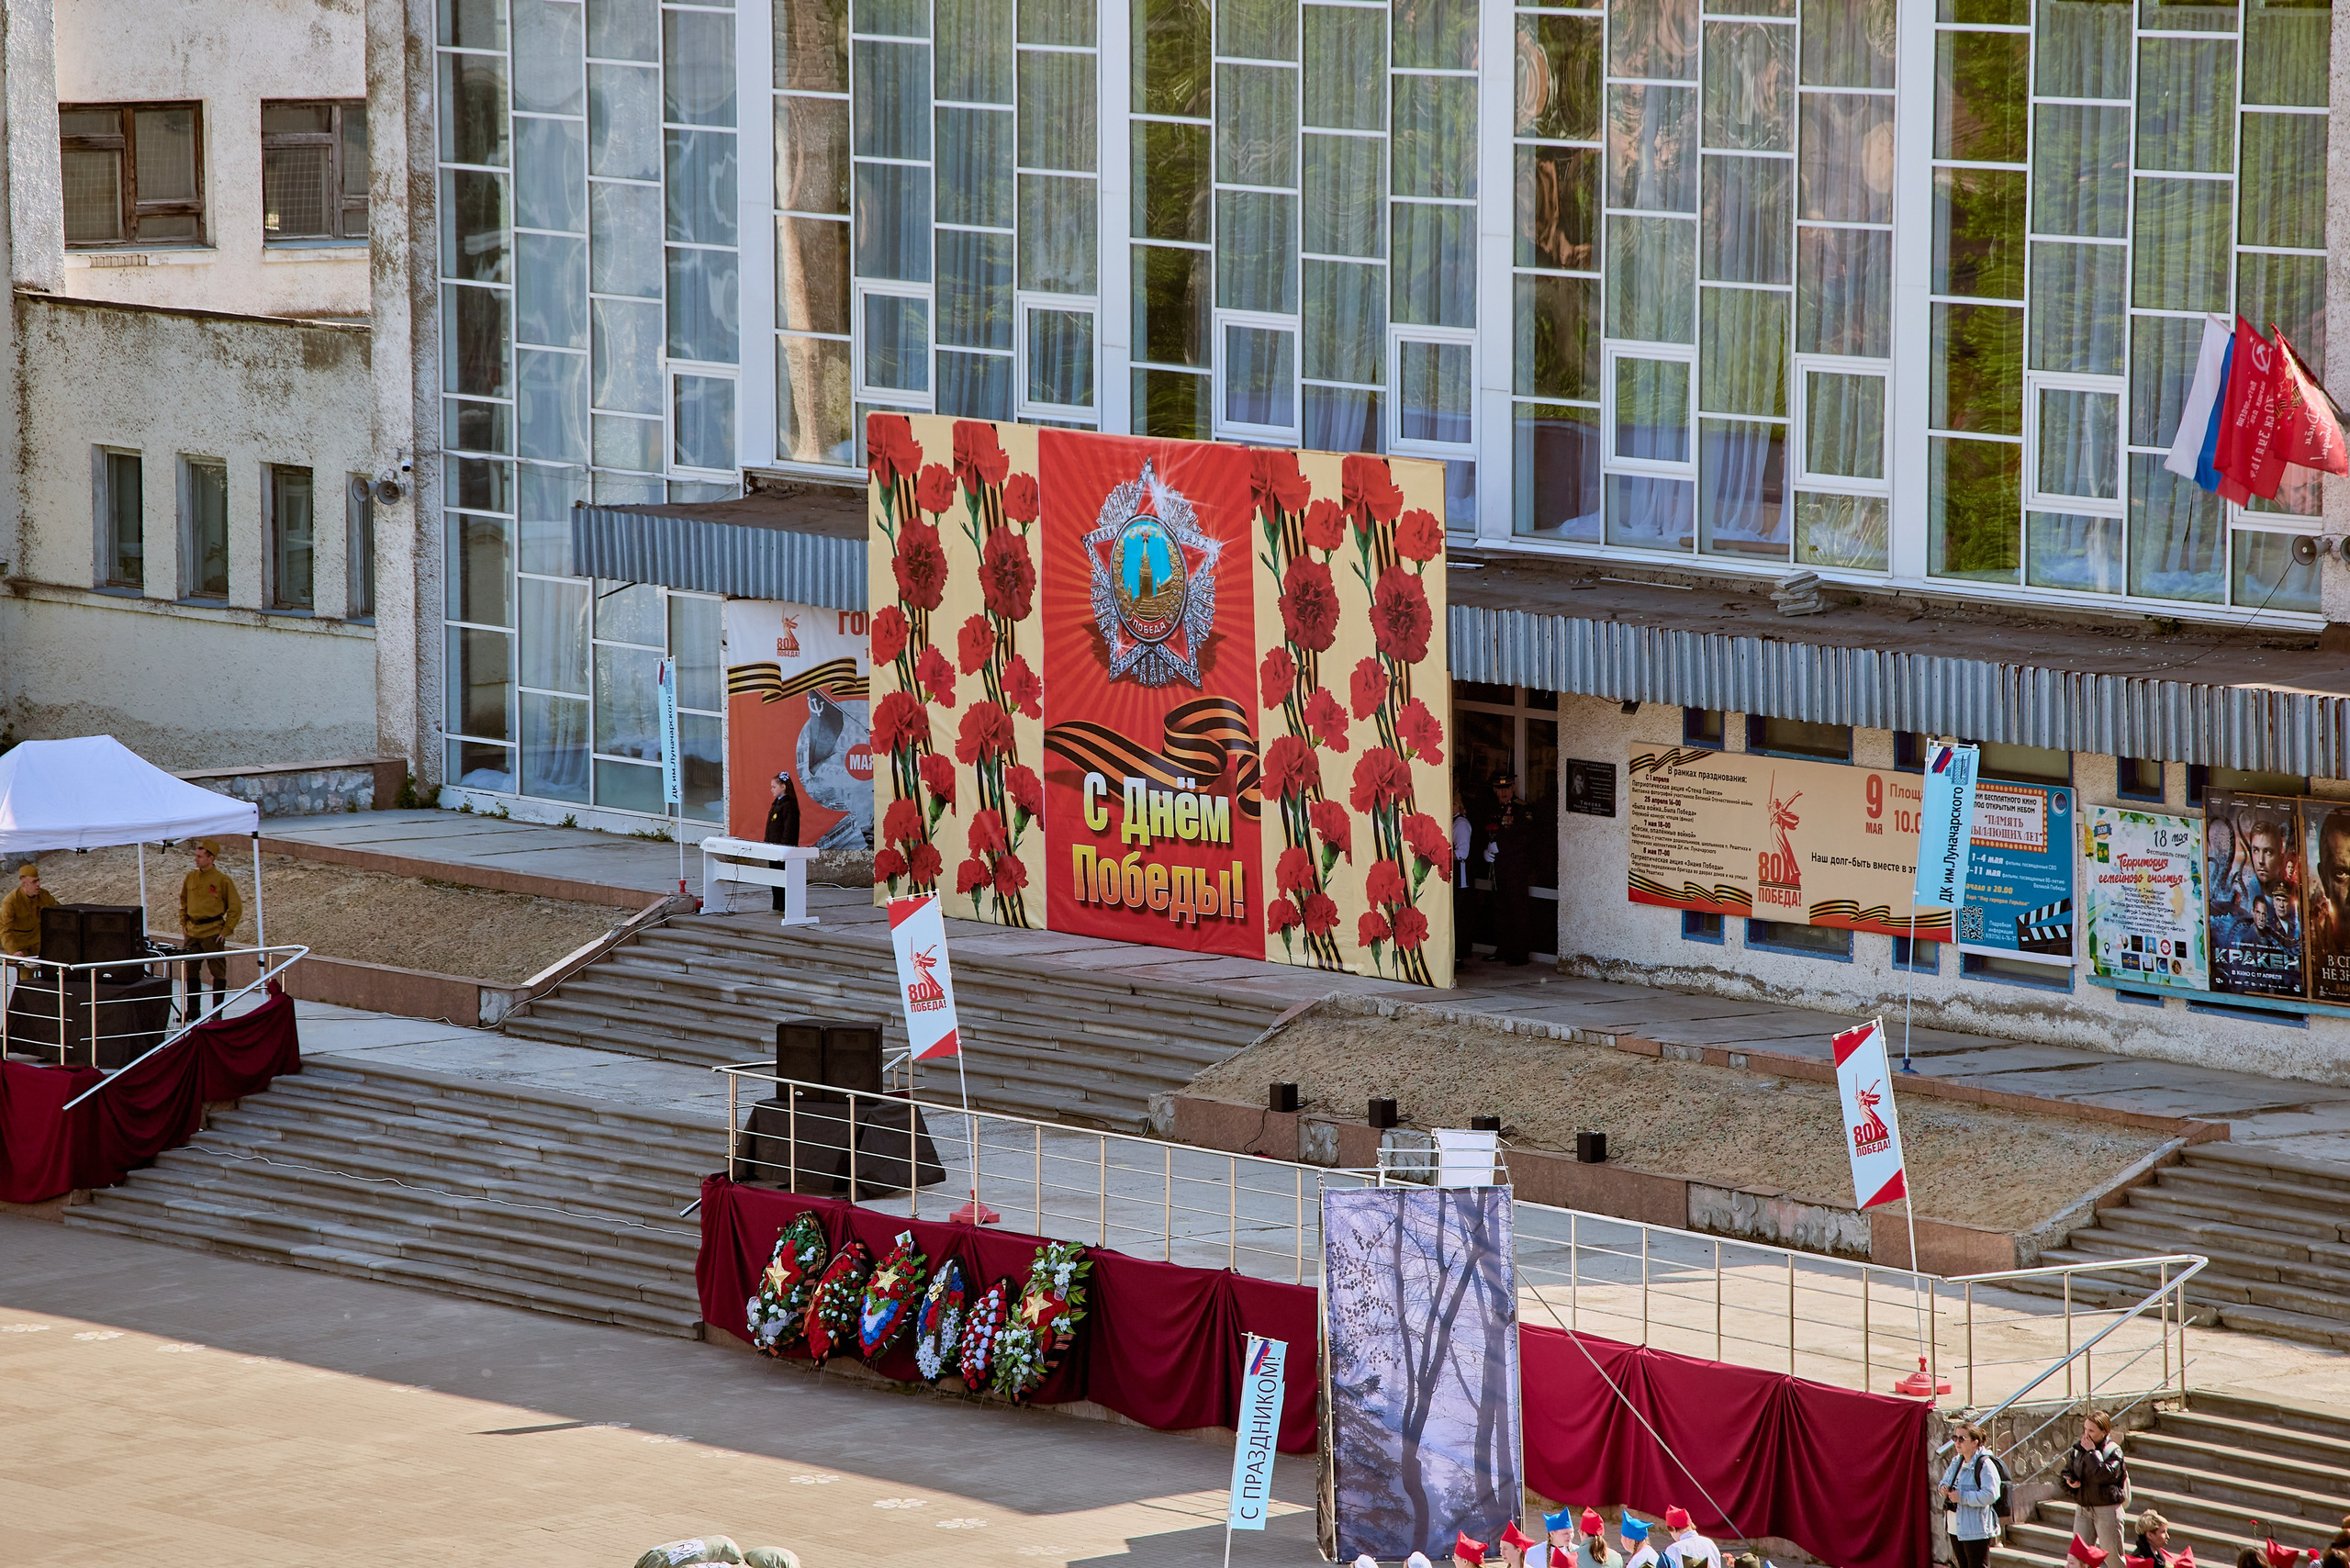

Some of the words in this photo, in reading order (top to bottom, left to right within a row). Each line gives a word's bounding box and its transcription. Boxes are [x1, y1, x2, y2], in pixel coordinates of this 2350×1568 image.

[1133, 619, 1166, 635] ПОБЕДА
[777, 637, 789, 649] 80
[1668, 766, 1673, 775] В
[1674, 769, 1696, 778] рамках
[1699, 772, 1747, 783] празднования:
[673, 784, 678, 799] ДК
[1632, 779, 1669, 790] Патриотическая
[1866, 774, 1883, 819] 9
[1985, 794, 2021, 804] БЕСПЛАТНОГО
[1083, 771, 1108, 831] С
[1121, 777, 1230, 846] Днём
[1986, 802, 2016, 812] ОТКРЫТЫМ
[1865, 822, 1883, 835] МАЯ
[1895, 810, 1922, 834] 10.0
[2154, 830, 2167, 847] 18
[2172, 833, 2188, 846] мая
[1631, 853, 1668, 863] Патриотическая
[1972, 853, 1986, 862] 1-4
[1987, 856, 2004, 865] мая
[2146, 848, 2174, 857] Фестиваль
[1759, 852, 1781, 882] 80
[1812, 852, 1829, 863] Наш
[1830, 856, 1871, 868] долг-быть
[1874, 862, 1899, 872] вместе
[1908, 866, 1917, 874] эт
[1986, 868, 2001, 878] мая
[2098, 872, 2143, 883] семейного
[1072, 843, 1244, 924] Победы!
[1965, 883, 1986, 891] ачало
[1993, 885, 2013, 894] 20.00
[1758, 887, 1801, 909] ПОБЕДА!
[1939, 886, 1953, 903] ДК
[2215, 947, 2300, 971] КРАКЕН
[2327, 955, 2334, 967] В
[2322, 968, 2337, 980] НЕ
[908, 982, 927, 1001] 80
[911, 1000, 947, 1013] ПОБЕДА!
[1853, 1123, 1874, 1144] 80
[1856, 1140, 1891, 1157] ПОБЕДА!
[1243, 1356, 1282, 1499] ПРАЗДНИКОМ!
[1241, 1506, 1259, 1520] С
